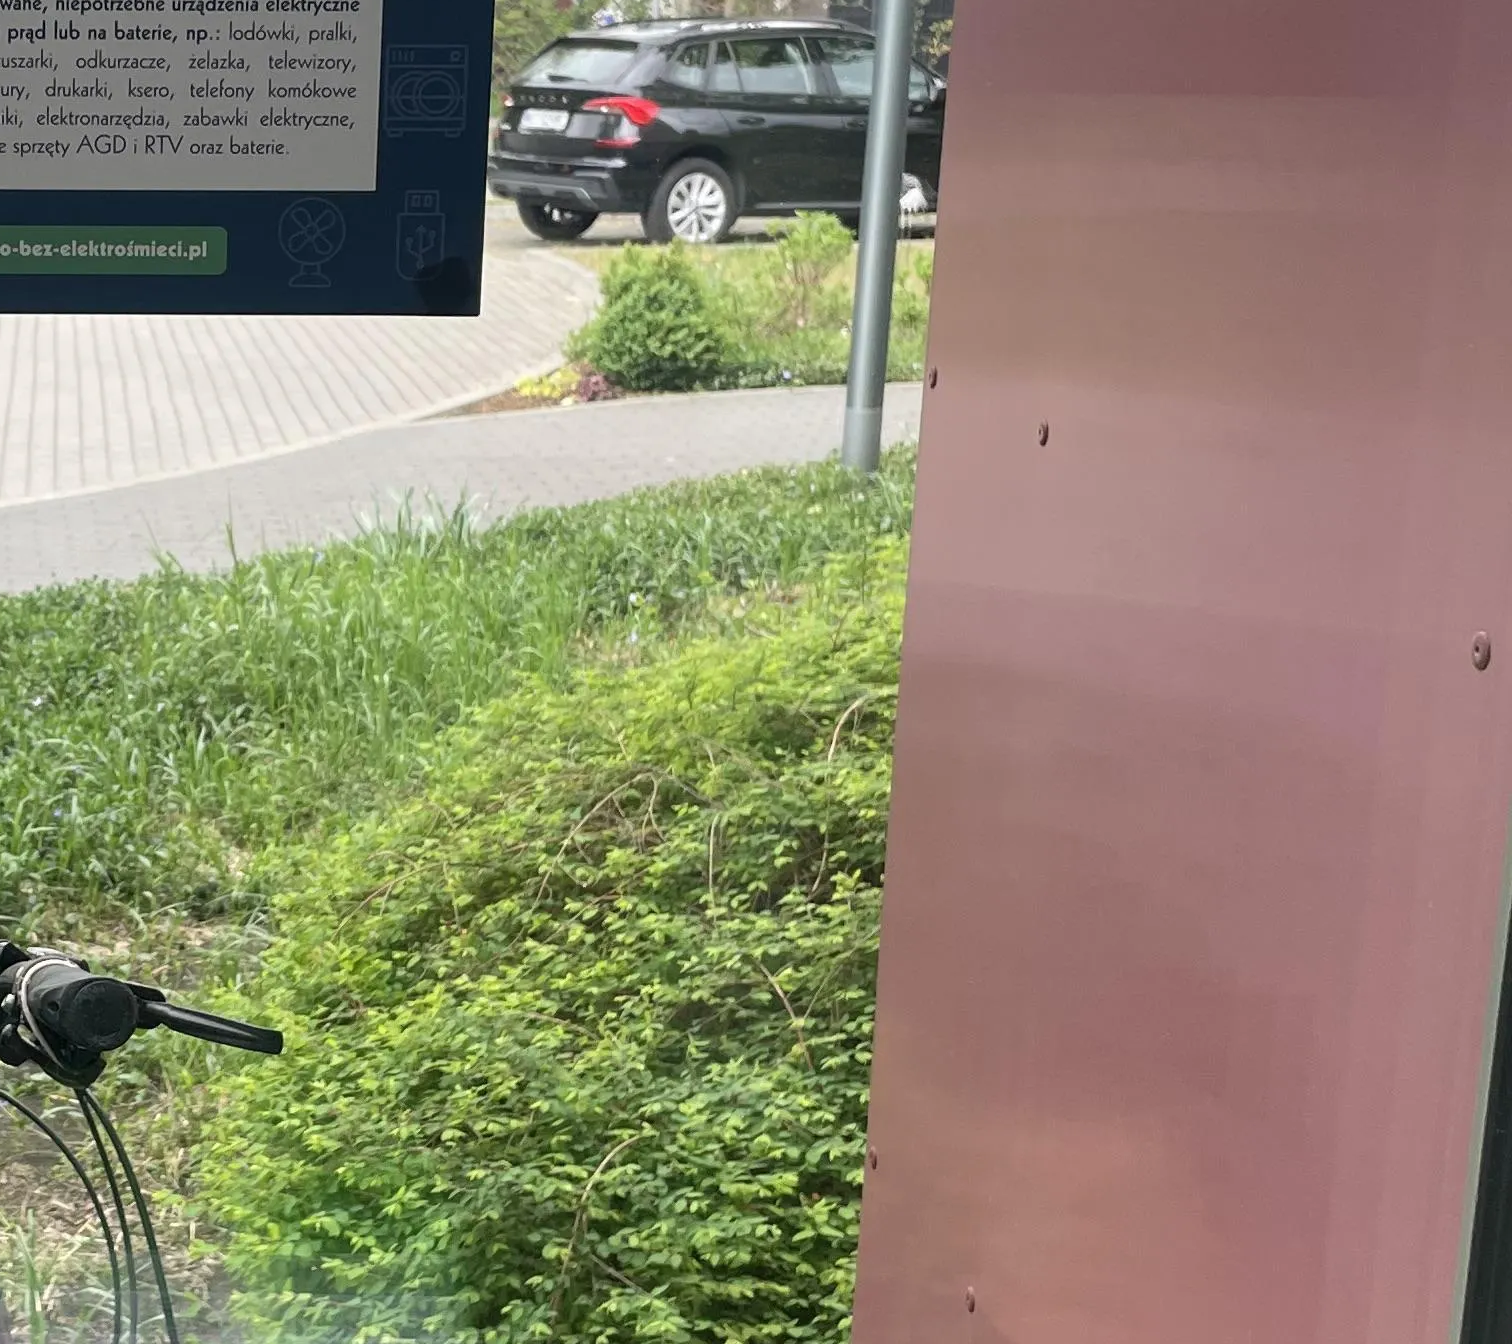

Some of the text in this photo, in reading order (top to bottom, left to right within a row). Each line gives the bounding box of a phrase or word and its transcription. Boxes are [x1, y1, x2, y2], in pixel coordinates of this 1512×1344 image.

[7, 19, 46, 46] prąd
[53, 19, 81, 41] lub
[87, 27, 107, 41] na
[114, 19, 178, 44] baterie,
[228, 19, 300, 45] lodówki,
[308, 19, 357, 46] pralki,
[75, 48, 171, 73] odkurzacze,
[188, 49, 251, 74] żelazka,
[268, 48, 357, 75] telewizory,
[44, 76, 113, 102] drukarki,
[127, 76, 175, 102] ksero,
[189, 77, 255, 104] telefony
[268, 77, 357, 99] komókowe
[36, 104, 170, 131] elektronarzędzia,
[183, 106, 249, 128] zabawki
[259, 105, 355, 131] elektryczne,
[12, 139, 71, 159] sprzęty
[75, 133, 127, 155] AGD
[133, 137, 138, 155] i
[144, 134, 184, 156] RTV
[189, 142, 224, 156] oraz
